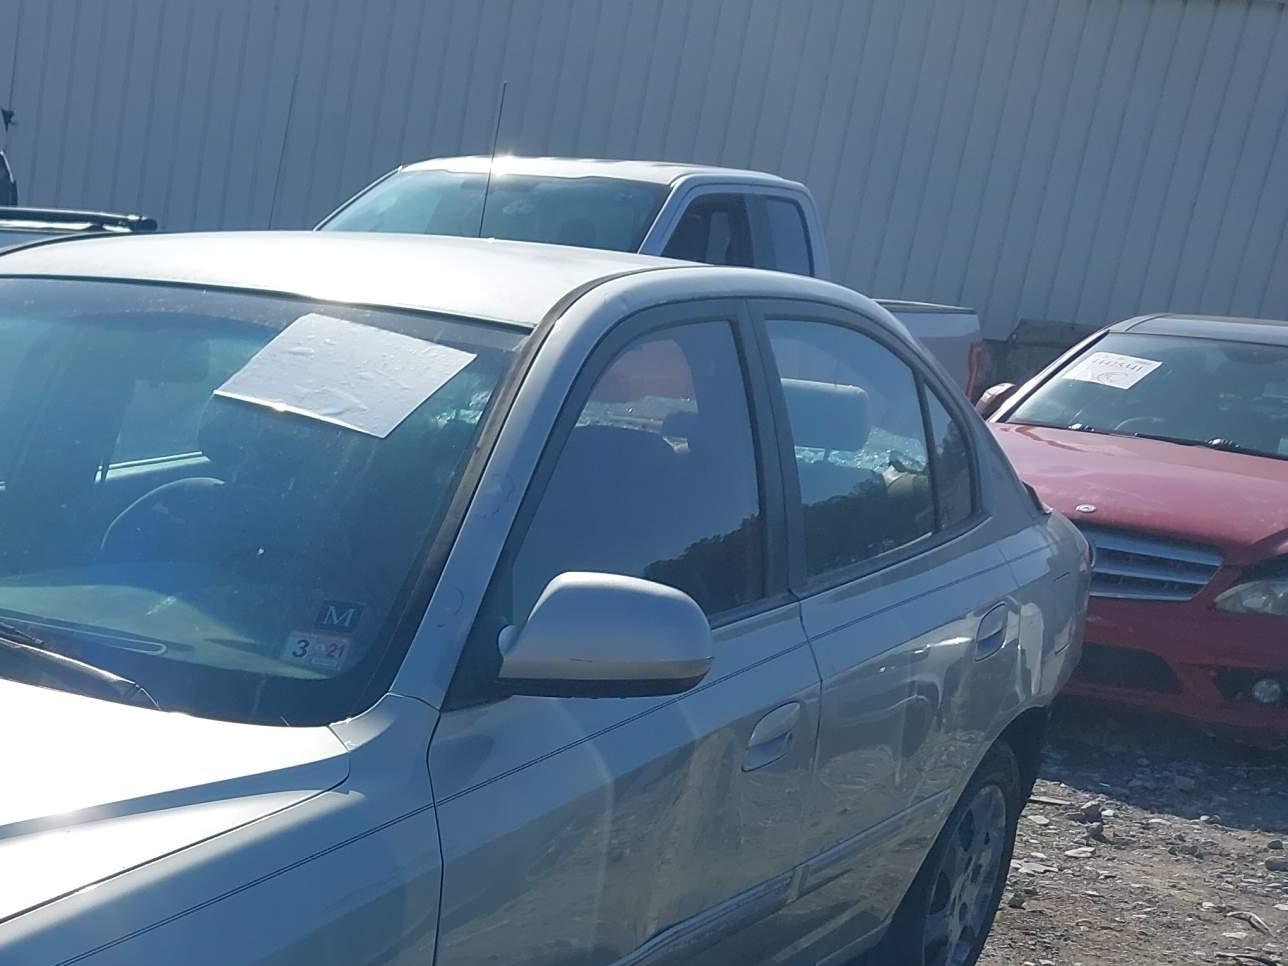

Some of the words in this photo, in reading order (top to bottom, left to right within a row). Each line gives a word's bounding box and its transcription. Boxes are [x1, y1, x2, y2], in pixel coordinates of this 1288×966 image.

[322, 605, 358, 628] M
[291, 639, 310, 659] 3
[326, 642, 346, 658] 21
